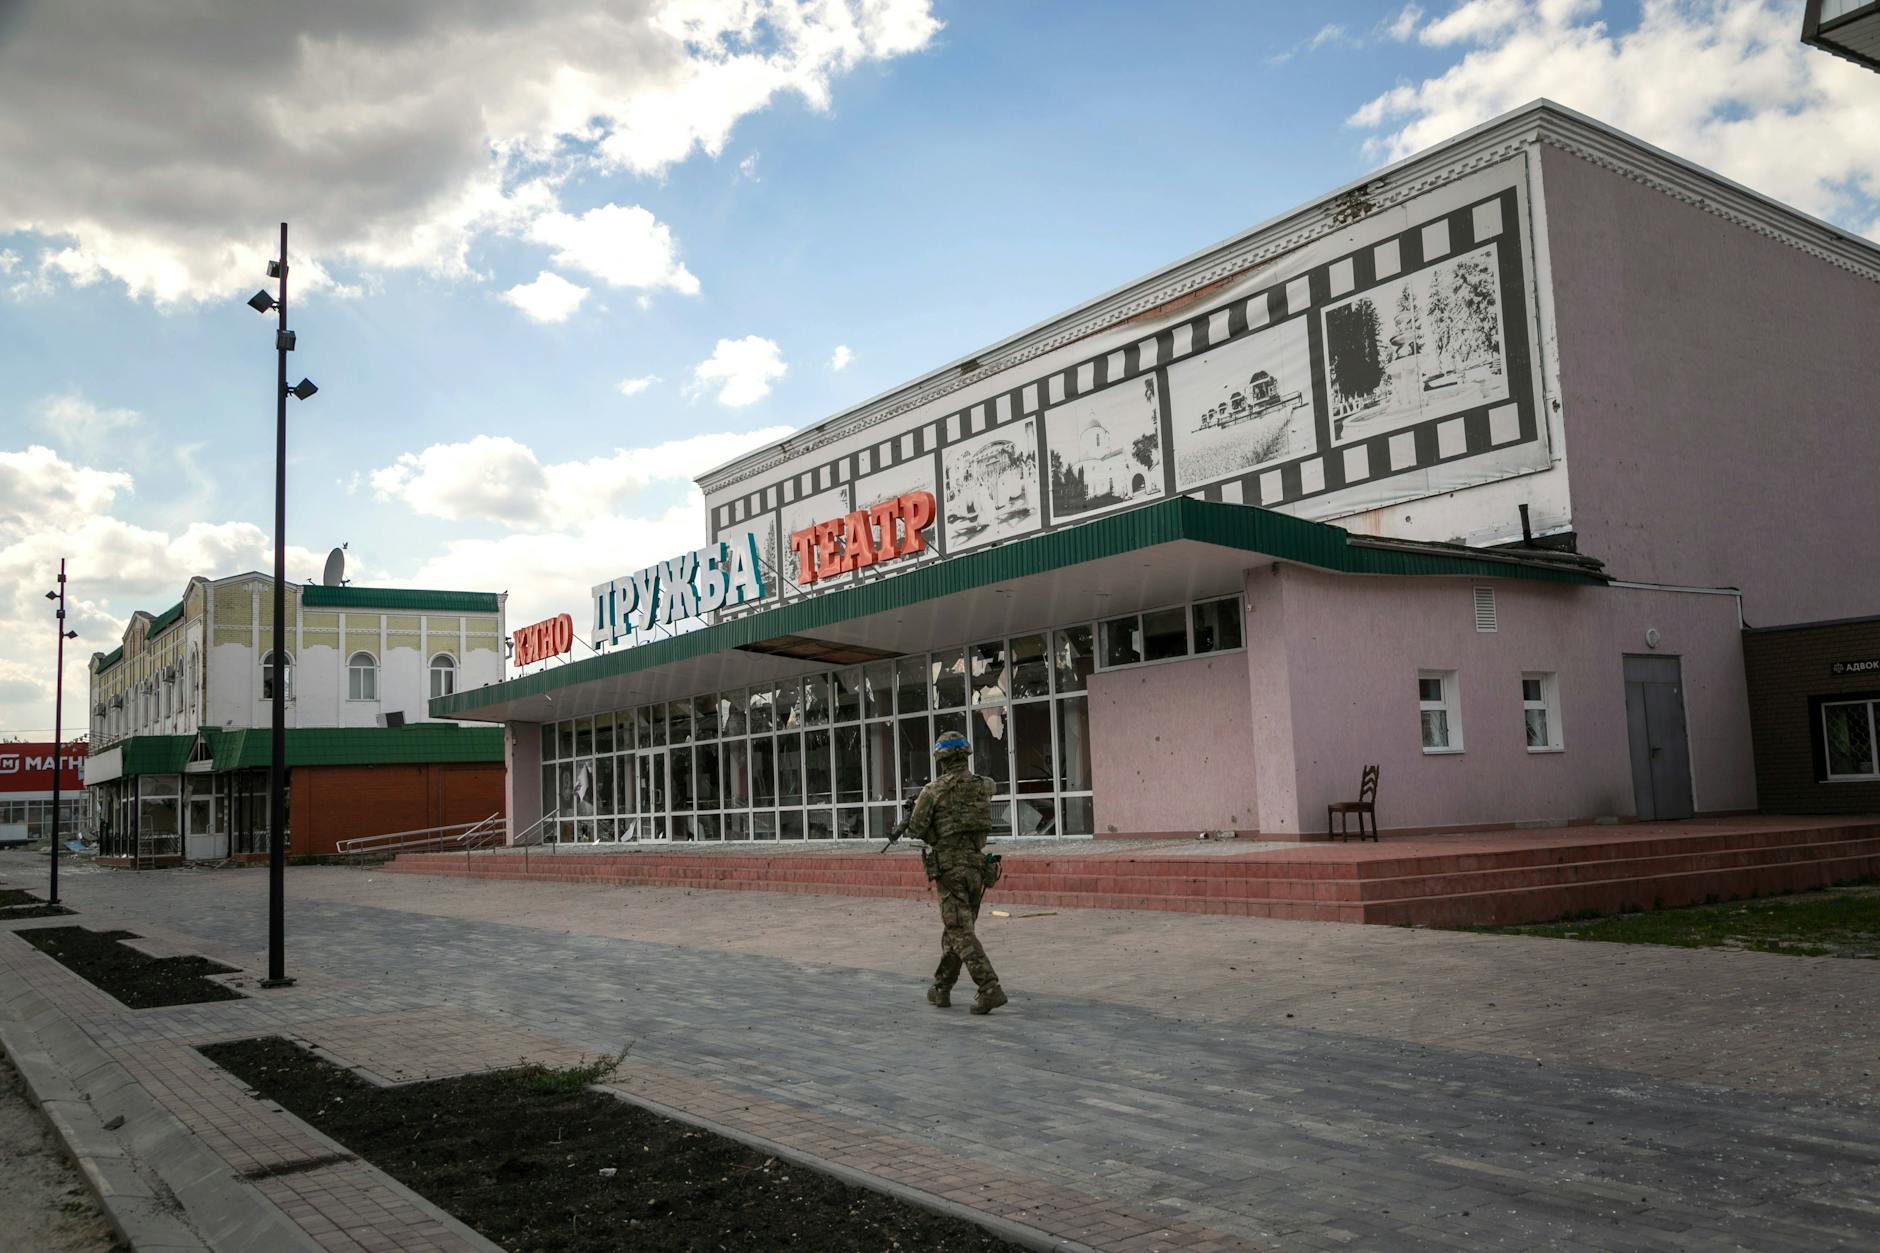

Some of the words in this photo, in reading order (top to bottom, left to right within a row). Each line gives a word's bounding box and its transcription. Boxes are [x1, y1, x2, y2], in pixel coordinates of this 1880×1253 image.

[513, 613, 573, 667] КИНО
[591, 532, 765, 650] ДРУЖБА
[792, 491, 936, 585] ТЕАТР
